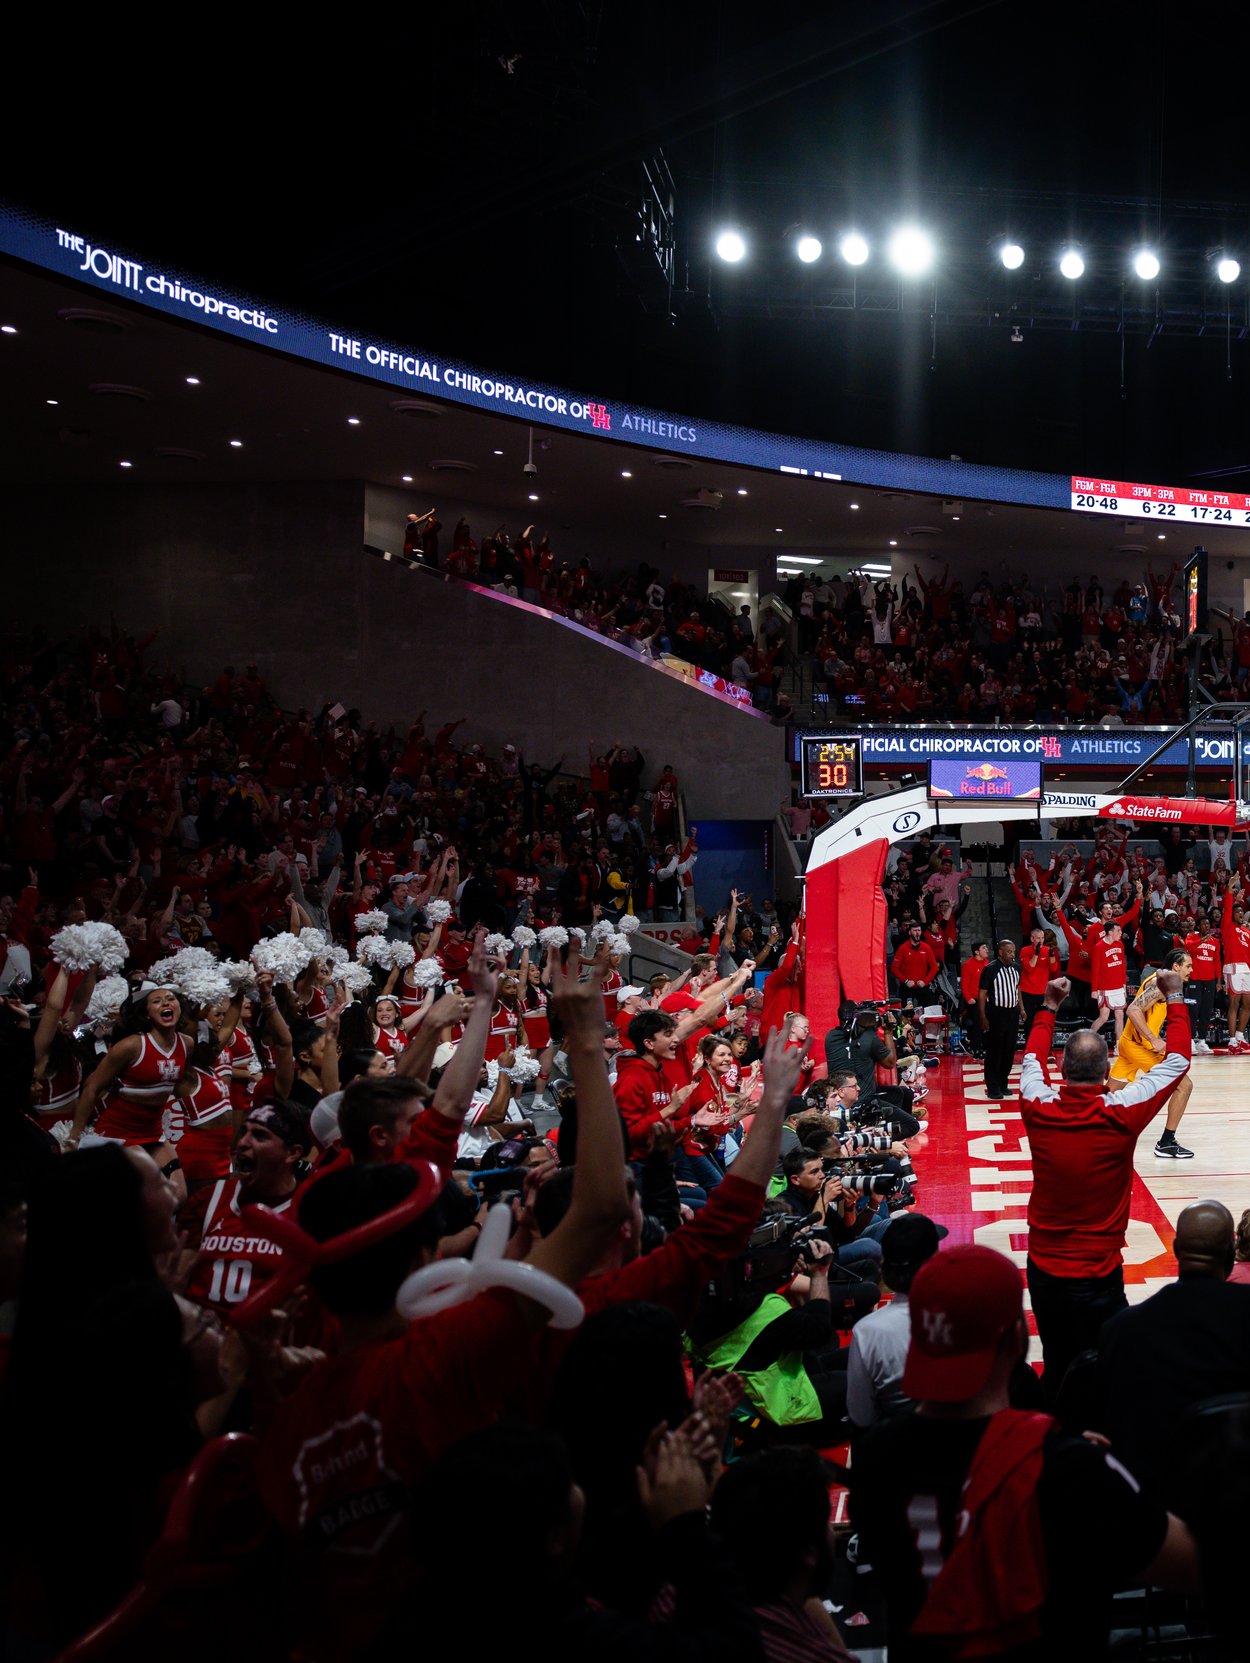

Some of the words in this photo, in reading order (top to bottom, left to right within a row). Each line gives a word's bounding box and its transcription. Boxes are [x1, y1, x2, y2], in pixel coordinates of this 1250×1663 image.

[56, 229, 84, 254] THE
[145, 274, 278, 334] chiropractic
[329, 332, 361, 360] THE
[365, 345, 440, 384] OFFICIAL
[443, 368, 567, 415] CHIROPRACTOR
[570, 401, 590, 421] OF
[621, 413, 697, 443] ATHLETICS
[1075, 479, 1094, 492] FGM
[1100, 483, 1117, 494] FGA
[1132, 486, 1152, 497] 3PM
[1158, 489, 1174, 500] 3PA
[1189, 492, 1207, 503] FTM
[1213, 495, 1229, 505] FTA
[1076, 494, 1118, 510] 20-48
[1142, 501, 1176, 516] 6-22
[1191, 506, 1232, 521] 17-24
[820, 745, 854, 762] 2:54
[863, 738, 906, 752] FICIAL
[909, 738, 1021, 753] CHIROPRACTOR
[1023, 739, 1041, 753] OF
[1071, 740, 1141, 753] ATHLETICS
[819, 764, 847, 787] 30
[208, 1258, 253, 1303] 10
